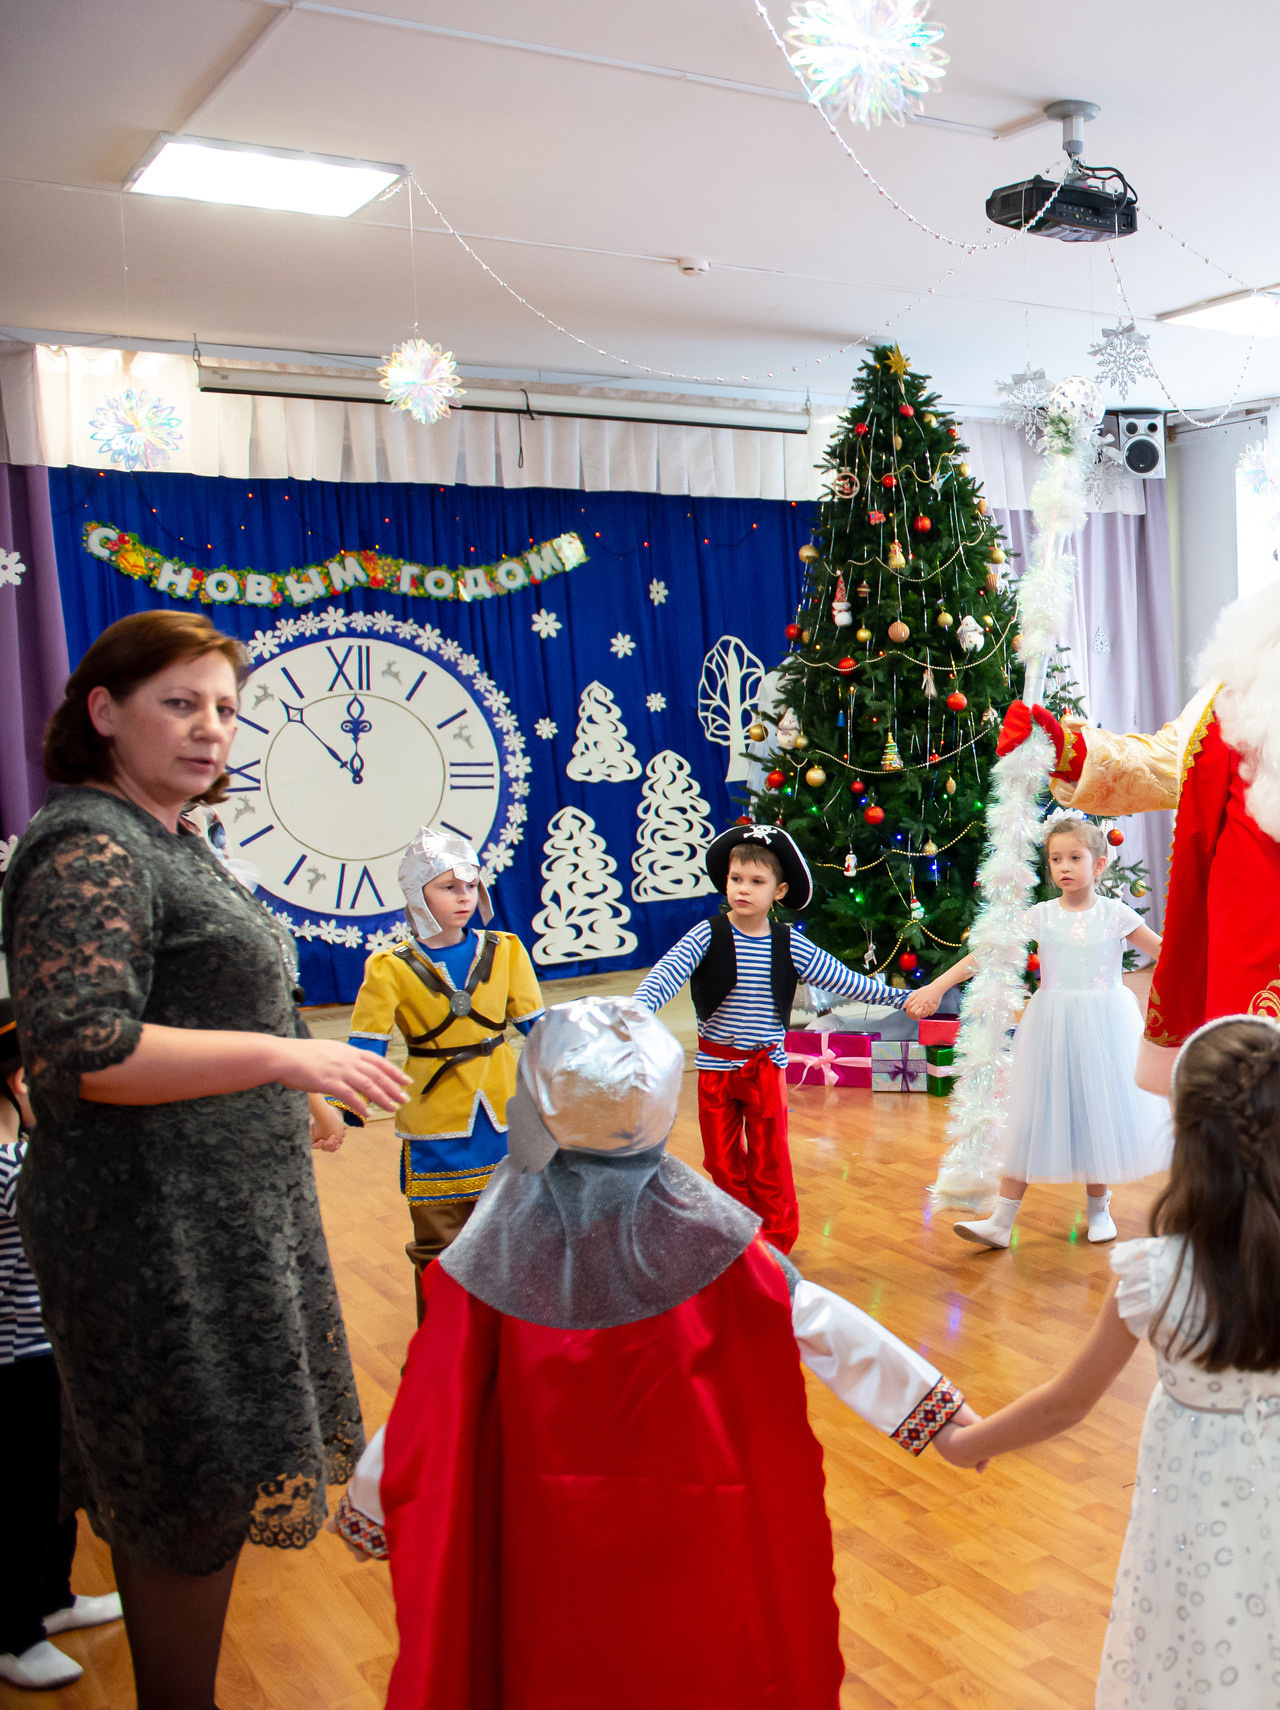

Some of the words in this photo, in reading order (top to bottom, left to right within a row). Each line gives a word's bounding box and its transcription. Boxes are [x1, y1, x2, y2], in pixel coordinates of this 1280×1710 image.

[88, 527, 118, 557] С
[156, 556, 368, 605] НОВЫМ
[326, 645, 371, 691] XII
